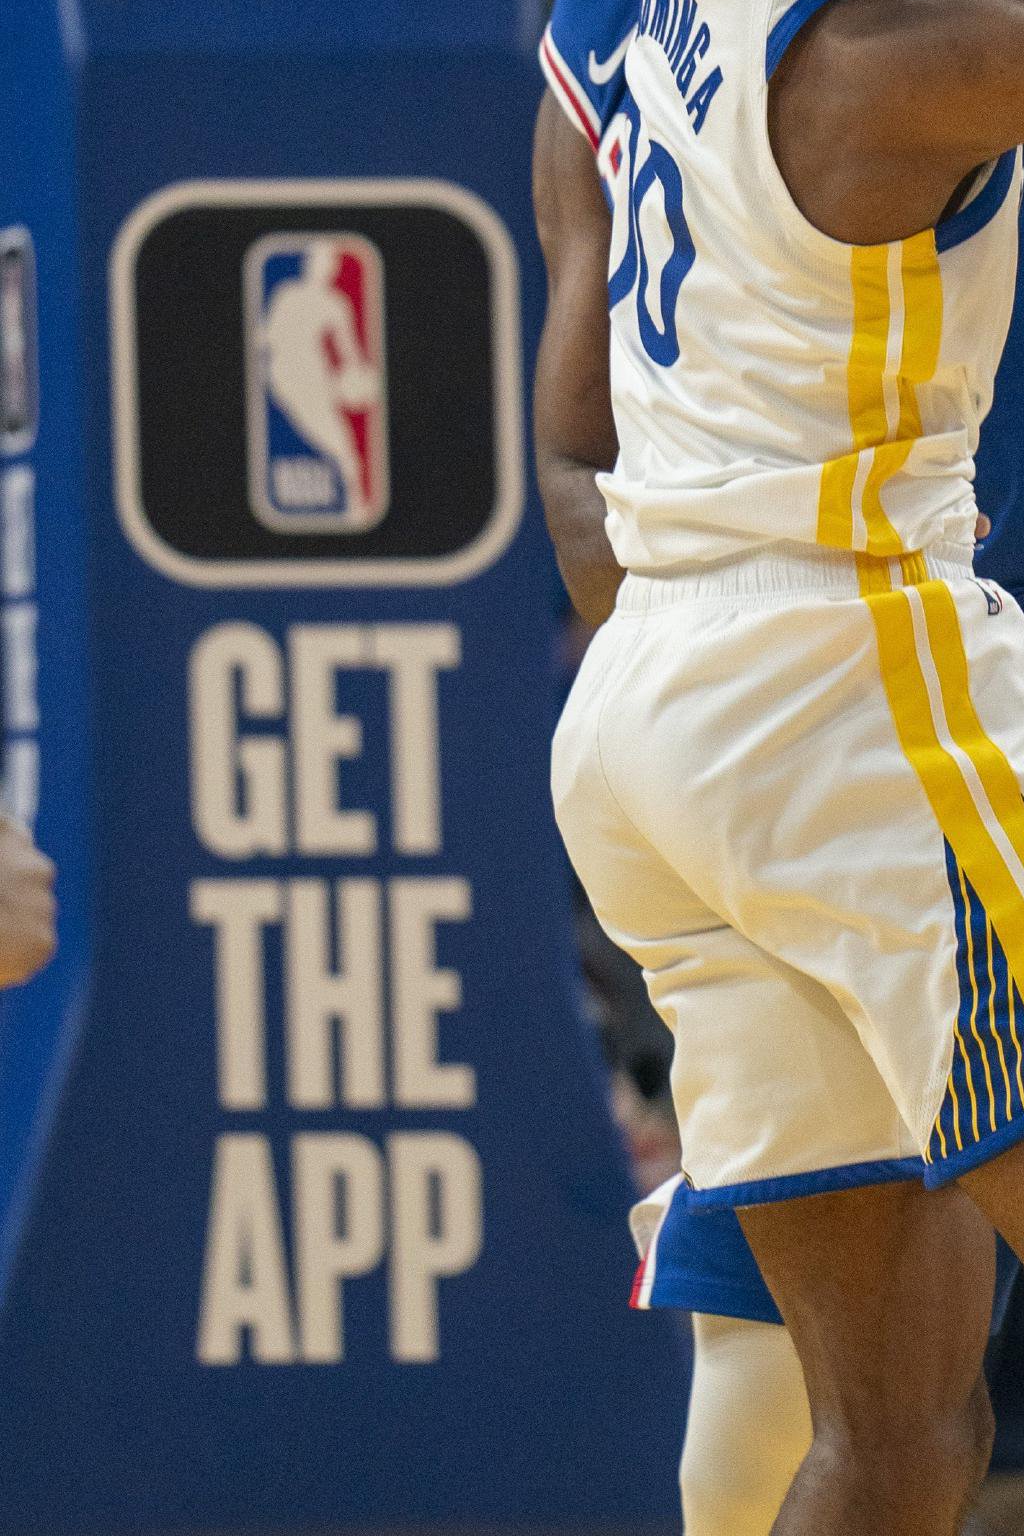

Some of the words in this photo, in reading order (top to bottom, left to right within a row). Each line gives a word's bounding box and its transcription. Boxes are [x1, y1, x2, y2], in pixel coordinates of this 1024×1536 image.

[191, 623, 460, 857] GET
[190, 878, 476, 1110] THE
[198, 1133, 482, 1364] APP
